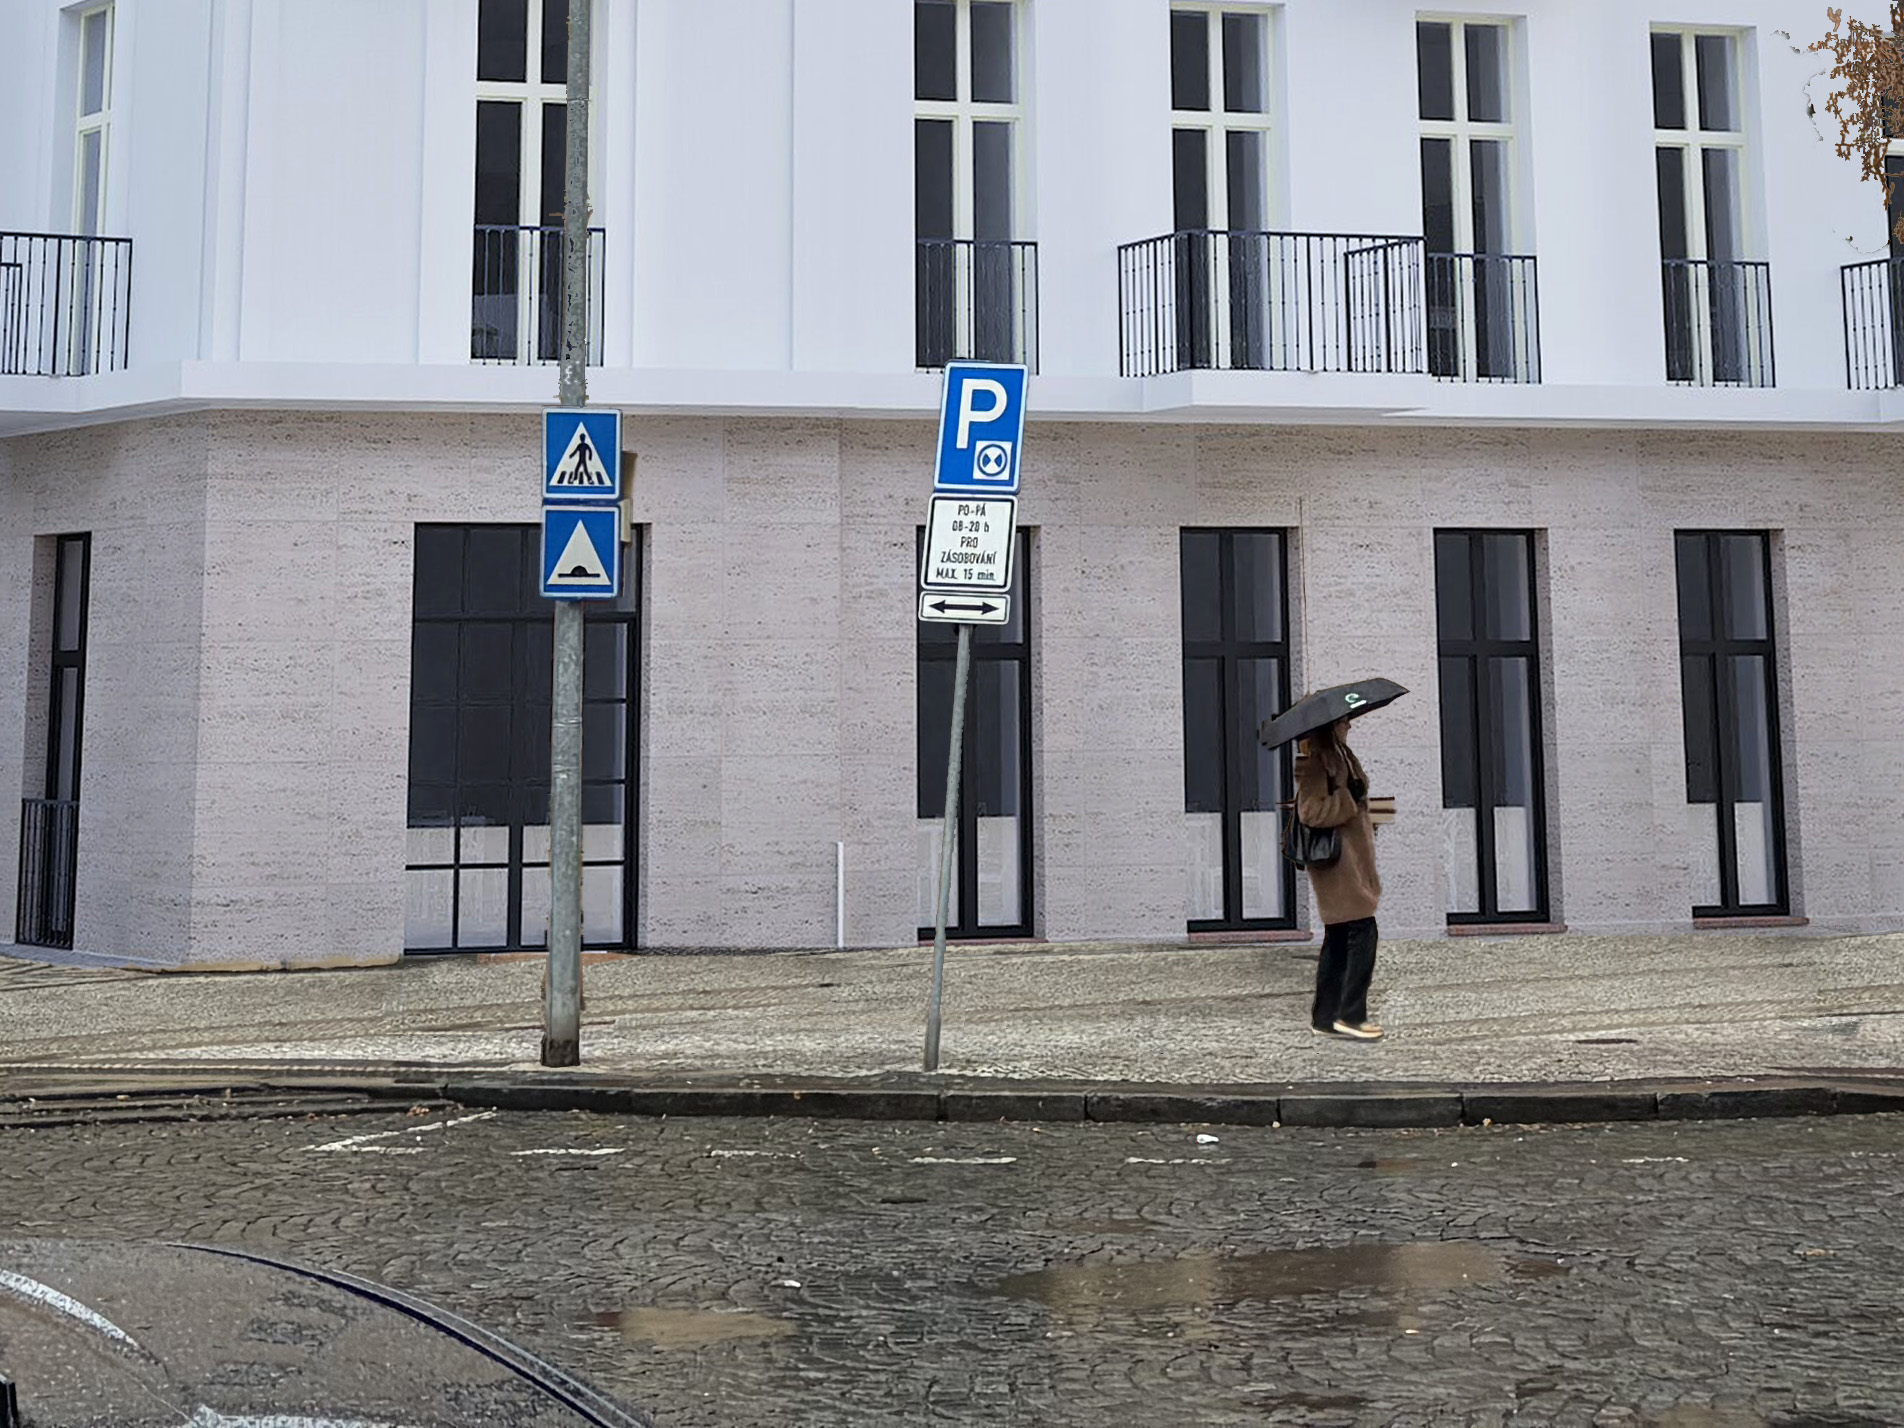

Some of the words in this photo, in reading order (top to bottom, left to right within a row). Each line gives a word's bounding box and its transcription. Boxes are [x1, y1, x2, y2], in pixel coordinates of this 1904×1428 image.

[956, 378, 1008, 449] P
[957, 502, 986, 517] PO-PÁ
[951, 520, 980, 532] 08-20
[984, 521, 990, 532] h
[960, 536, 979, 548] PRO
[940, 549, 997, 564] ZÁSOBOVÁNÍ
[963, 568, 974, 580] 15
